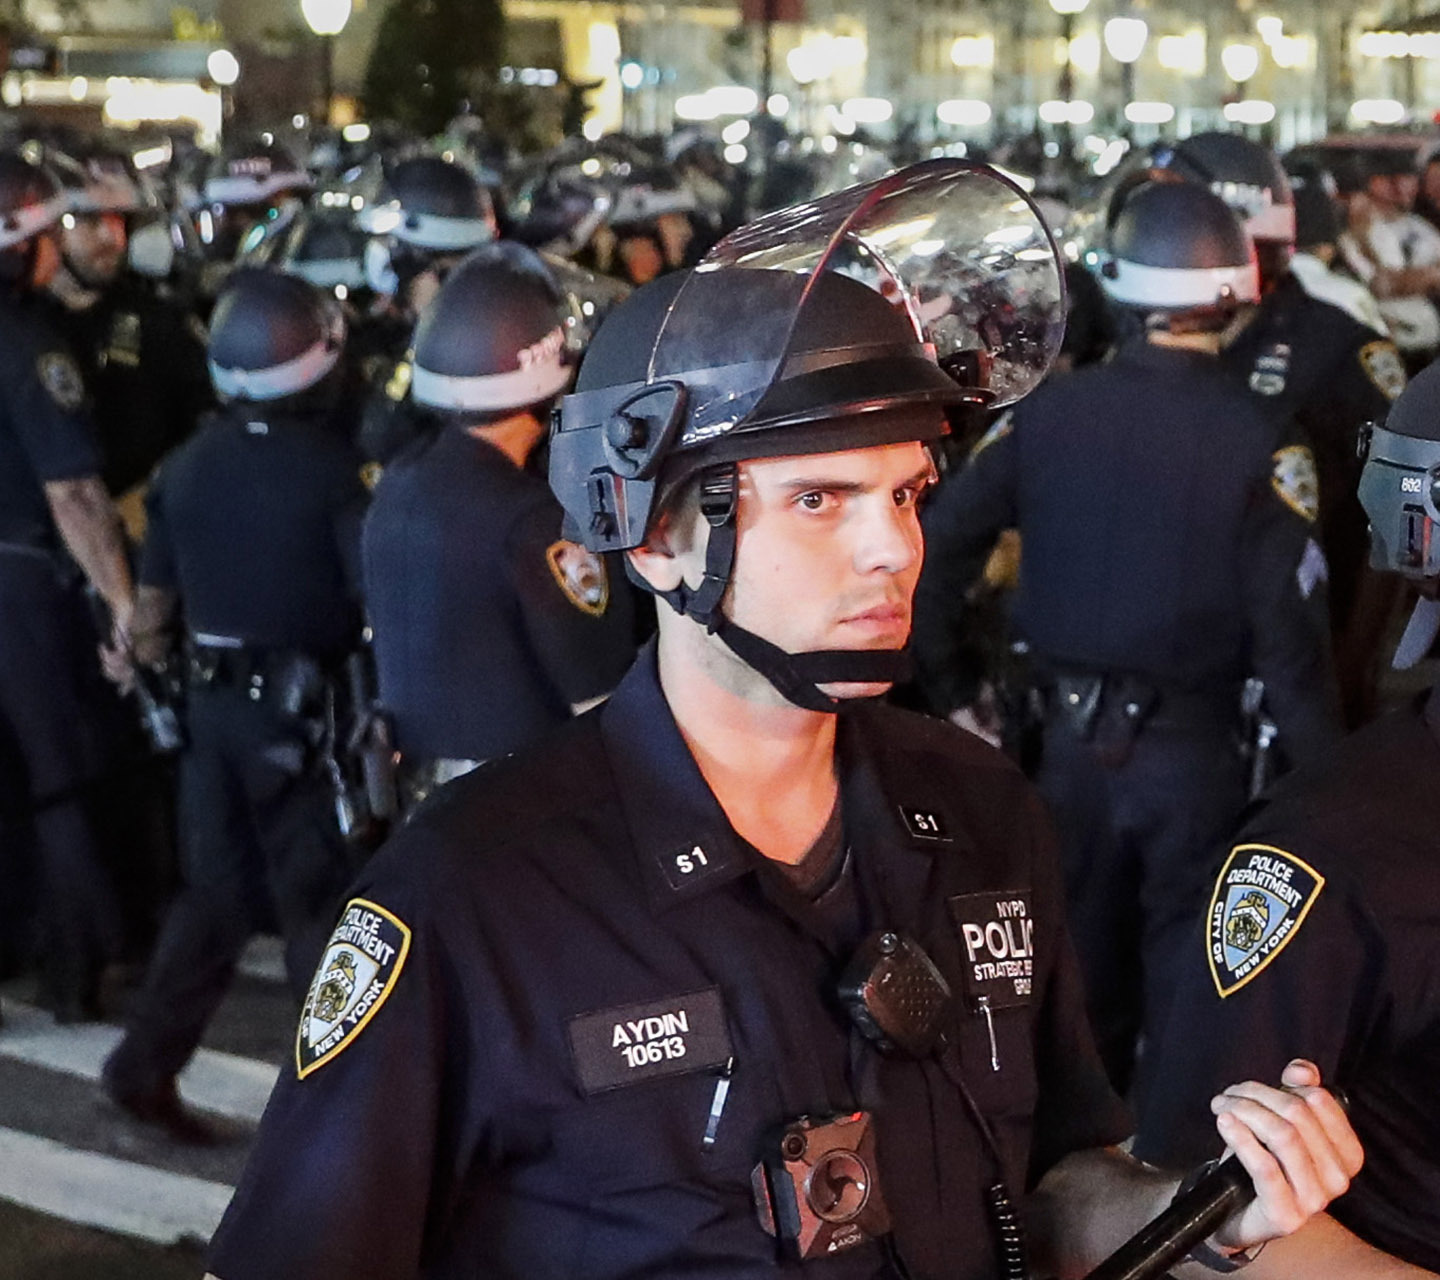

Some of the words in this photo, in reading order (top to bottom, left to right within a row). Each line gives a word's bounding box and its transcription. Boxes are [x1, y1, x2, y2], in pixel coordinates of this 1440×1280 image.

[915, 814, 939, 831] S1
[676, 846, 708, 873] S1
[1249, 855, 1294, 882] POLICE
[1227, 869, 1302, 908] DEPARTMENT
[996, 900, 1026, 918] NYPD
[1212, 901, 1224, 938] CITY
[1213, 942, 1224, 963] OF
[1234, 953, 1260, 979] NEW
[1260, 918, 1294, 954] YORK
[315, 1025, 345, 1057] NEW
[346, 979, 385, 1024] YORK
[612, 1010, 689, 1048] AYDIN
[622, 1036, 686, 1067] 10613
